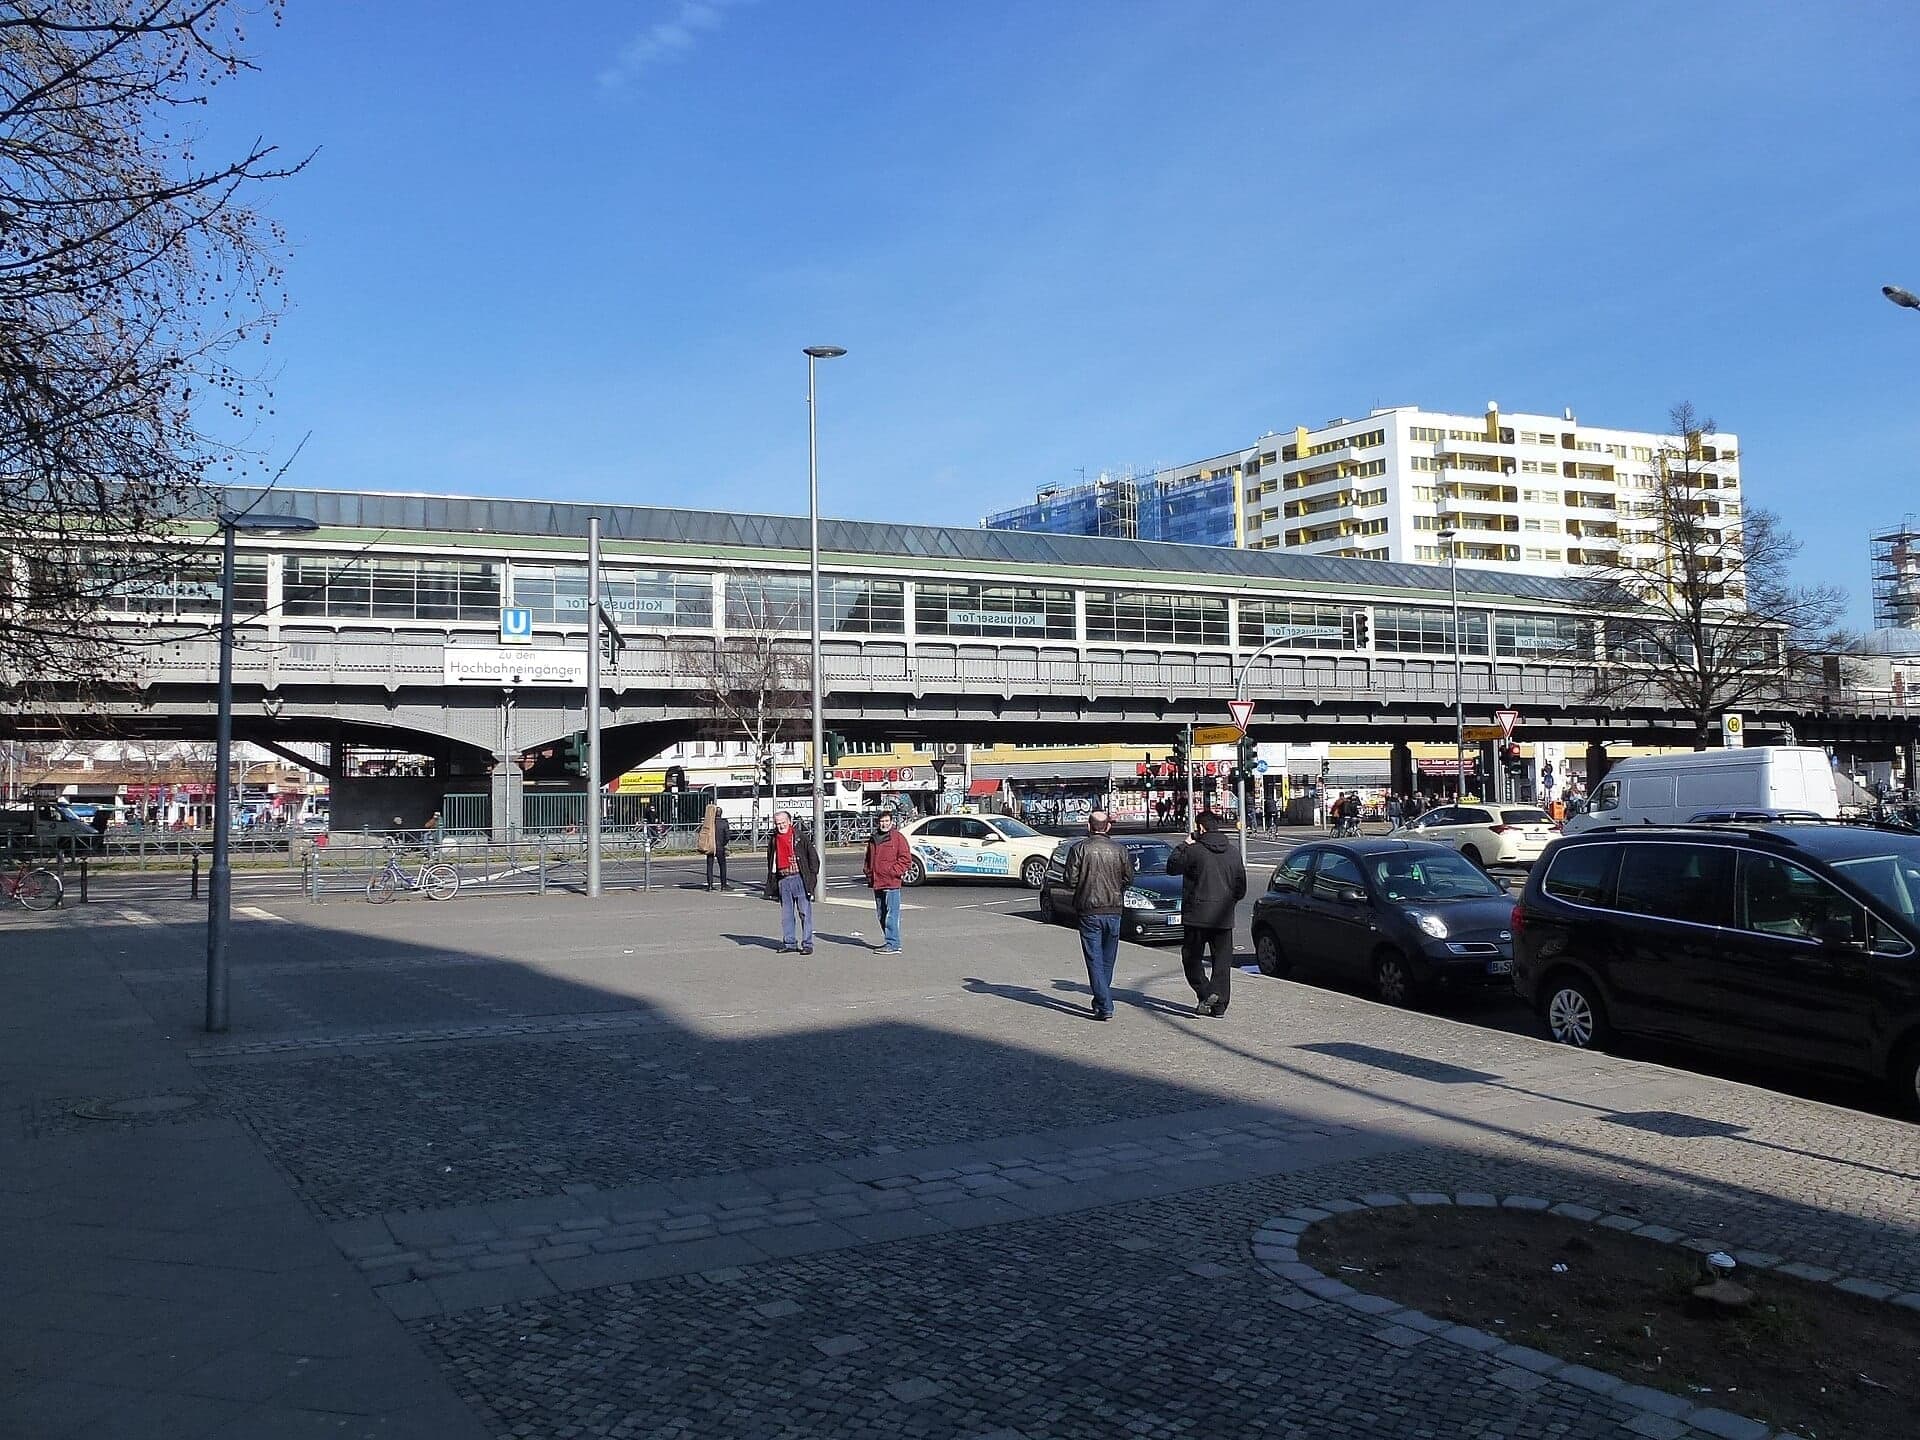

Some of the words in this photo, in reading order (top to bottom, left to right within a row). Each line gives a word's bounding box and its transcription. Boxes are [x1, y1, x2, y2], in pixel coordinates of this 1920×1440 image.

[507, 611, 527, 634] U
[516, 651, 536, 660] den
[450, 661, 582, 678] Hochbahneingängen
